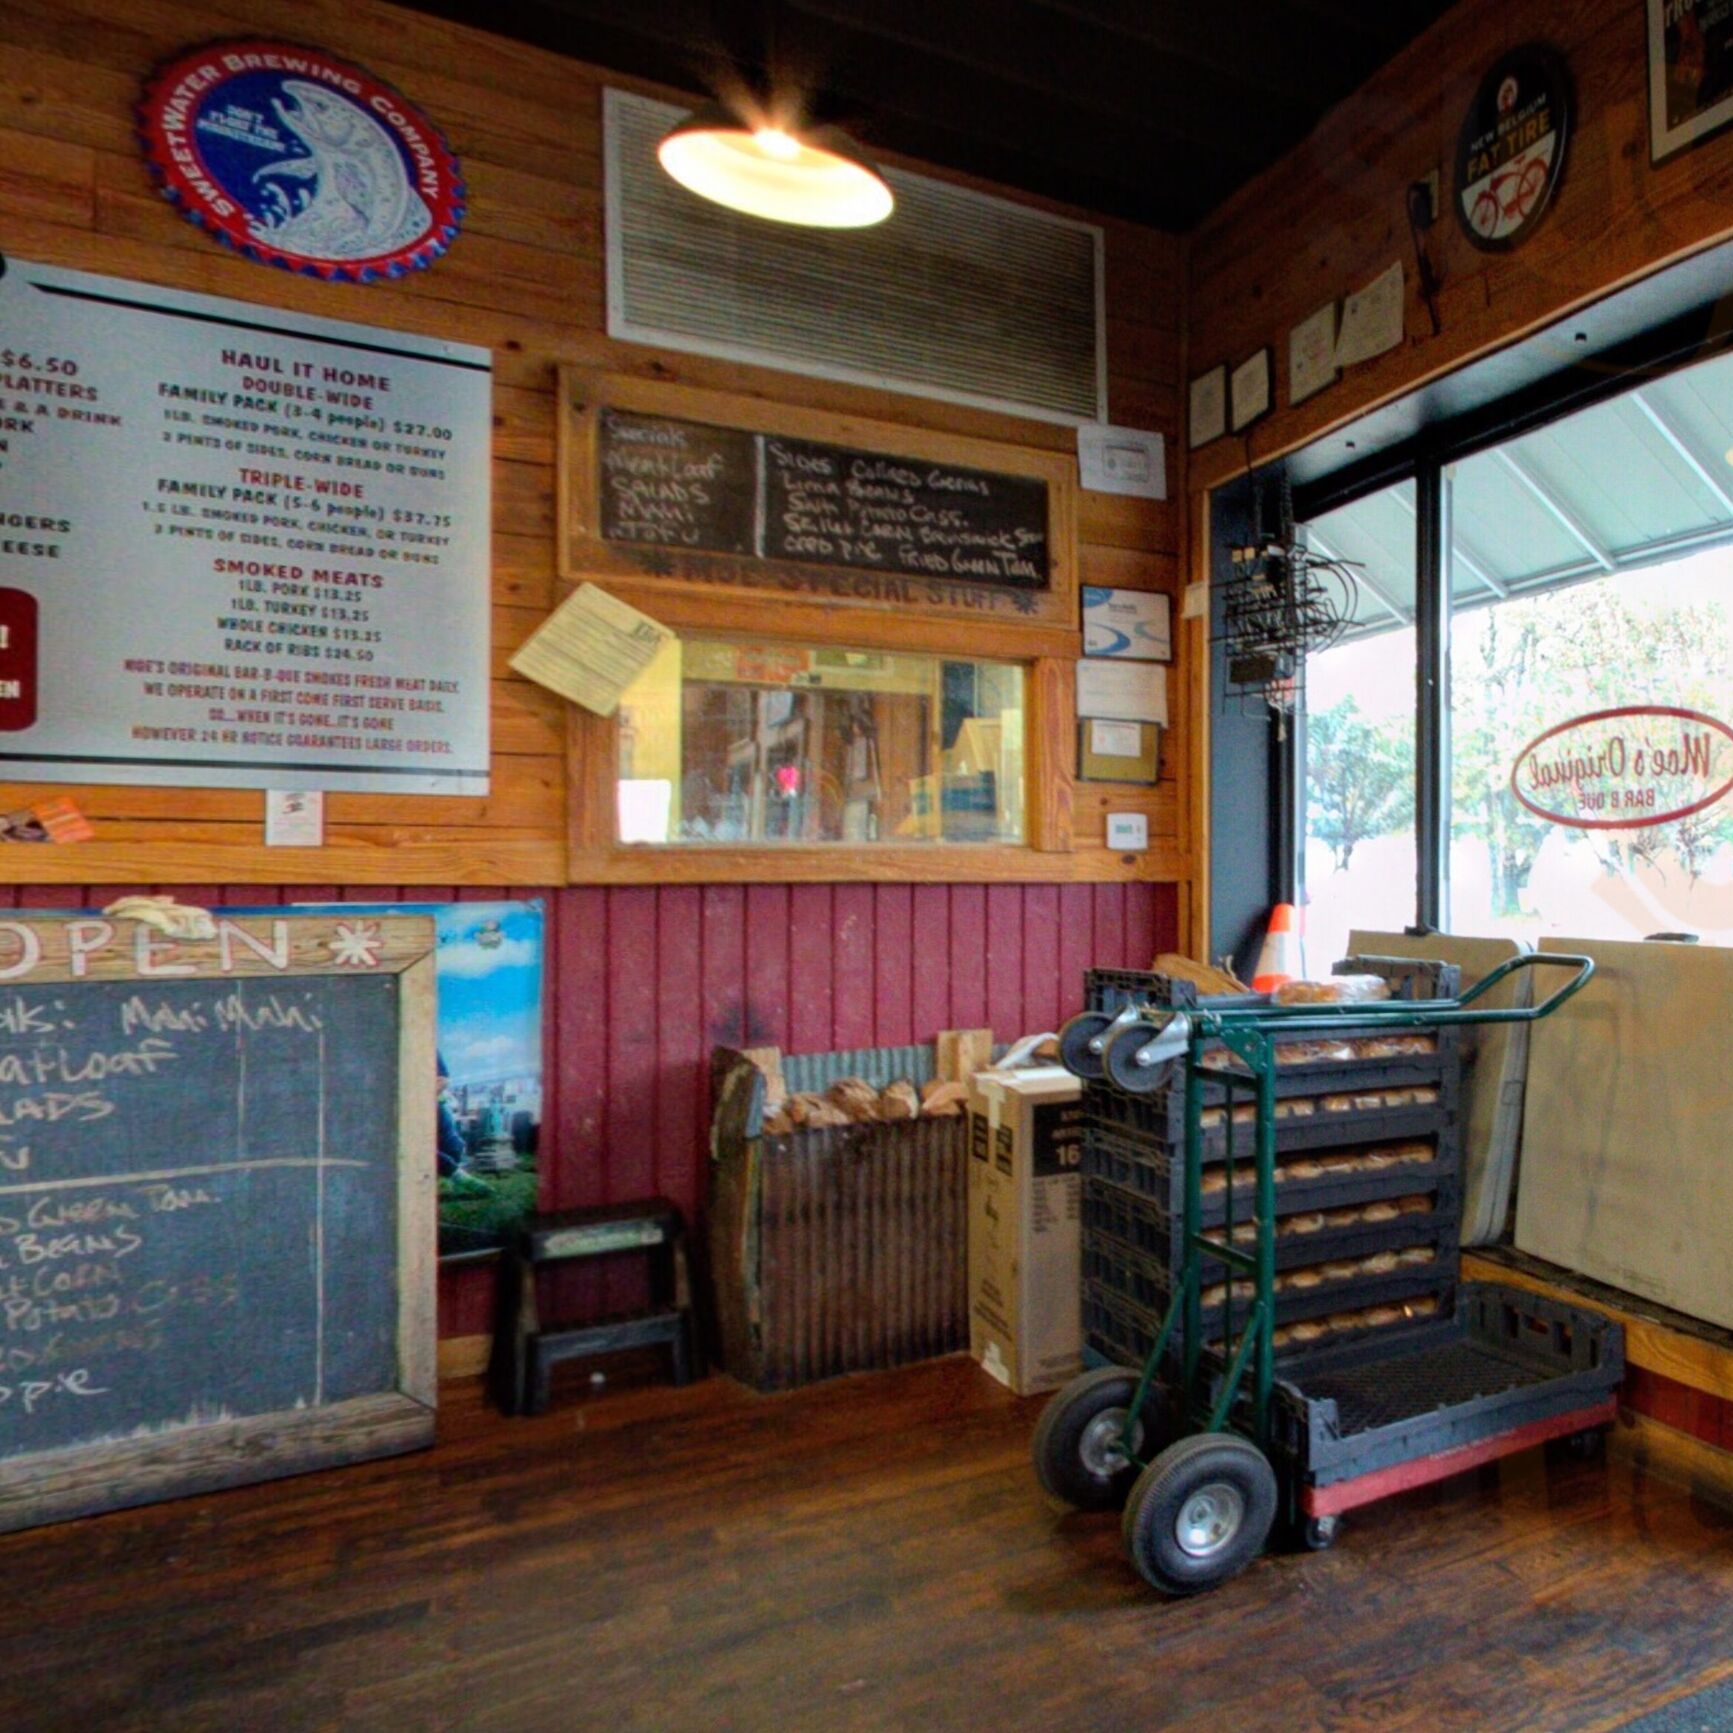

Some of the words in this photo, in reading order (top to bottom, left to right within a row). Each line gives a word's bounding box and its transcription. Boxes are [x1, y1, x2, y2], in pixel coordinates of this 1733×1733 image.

[221, 54, 362, 95] BREWING
[369, 95, 439, 199] COMPANY
[1467, 142, 1500, 183] FAT
[1506, 107, 1550, 156] TIRE
[1, 348, 78, 376] $6.50
[222, 349, 284, 374] HAUL
[293, 362, 314, 377] IT
[323, 367, 391, 392] HOME
[0, 372, 98, 402] LATTERS
[243, 376, 373, 410] DOUBLE-WIDE
[0, 417, 34, 434] RK
[57, 406, 122, 427] DRINK
[158, 382, 228, 405] FAMILY
[233, 394, 278, 412] PACK
[393, 420, 453, 441] $27.00
[202, 414, 259, 432] SMOKED
[308, 431, 367, 448] CHICKEN
[372, 440, 391, 451] OR
[396, 443, 446, 460] TURKEY
[177, 433, 221, 449] PINTS
[225, 439, 241, 450] OF
[294, 450, 331, 463] CORN
[336, 456, 381, 471] BREAD
[386, 463, 405, 474] OR
[410, 466, 445, 480] BUNS
[158, 478, 227, 499] FAMILY
[233, 488, 277, 505] PACK
[239, 468, 364, 498] TRIPLE-WIDE
[169, 524, 214, 540] PINTS
[217, 530, 234, 541] OF
[286, 537, 325, 551] CORN
[329, 543, 375, 557] BREAD
[378, 548, 398, 560] OR
[202, 508, 259, 524] SMOKED
[375, 529, 395, 541] OR
[400, 531, 450, 546] TURKEY
[213, 558, 303, 579] SMOKED
[312, 569, 385, 588] MEATS
[271, 582, 310, 596] PORK
[265, 600, 318, 617] TURKEY
[217, 617, 264, 633] WHOLE
[268, 621, 329, 638] CHICKEN
[225, 638, 262, 652] RACK
[266, 642, 283, 654] OF
[287, 643, 320, 657] RIBS
[168, 661, 230, 678] ORIGINAL
[304, 671, 350, 687] SMOKES
[355, 673, 392, 689] FRESH
[395, 678, 425, 691] MEAT
[143, 682, 163, 697] WE
[167, 683, 225, 700] OPERATE
[228, 687, 245, 701] ON
[248, 688, 256, 701] A
[261, 688, 293, 704] FIRST
[296, 691, 329, 706] COME
[332, 693, 366, 708] FIRST
[368, 696, 406, 711] SERVE
[131, 725, 196, 742] HOWEVER
[202, 729, 218, 742] 24
[221, 730, 238, 743] HR
[242, 731, 283, 746] NOTICE
[286, 733, 362, 750] GUARANTEES
[365, 737, 402, 751] LARGE
[362, 716, 395, 731] GONE
